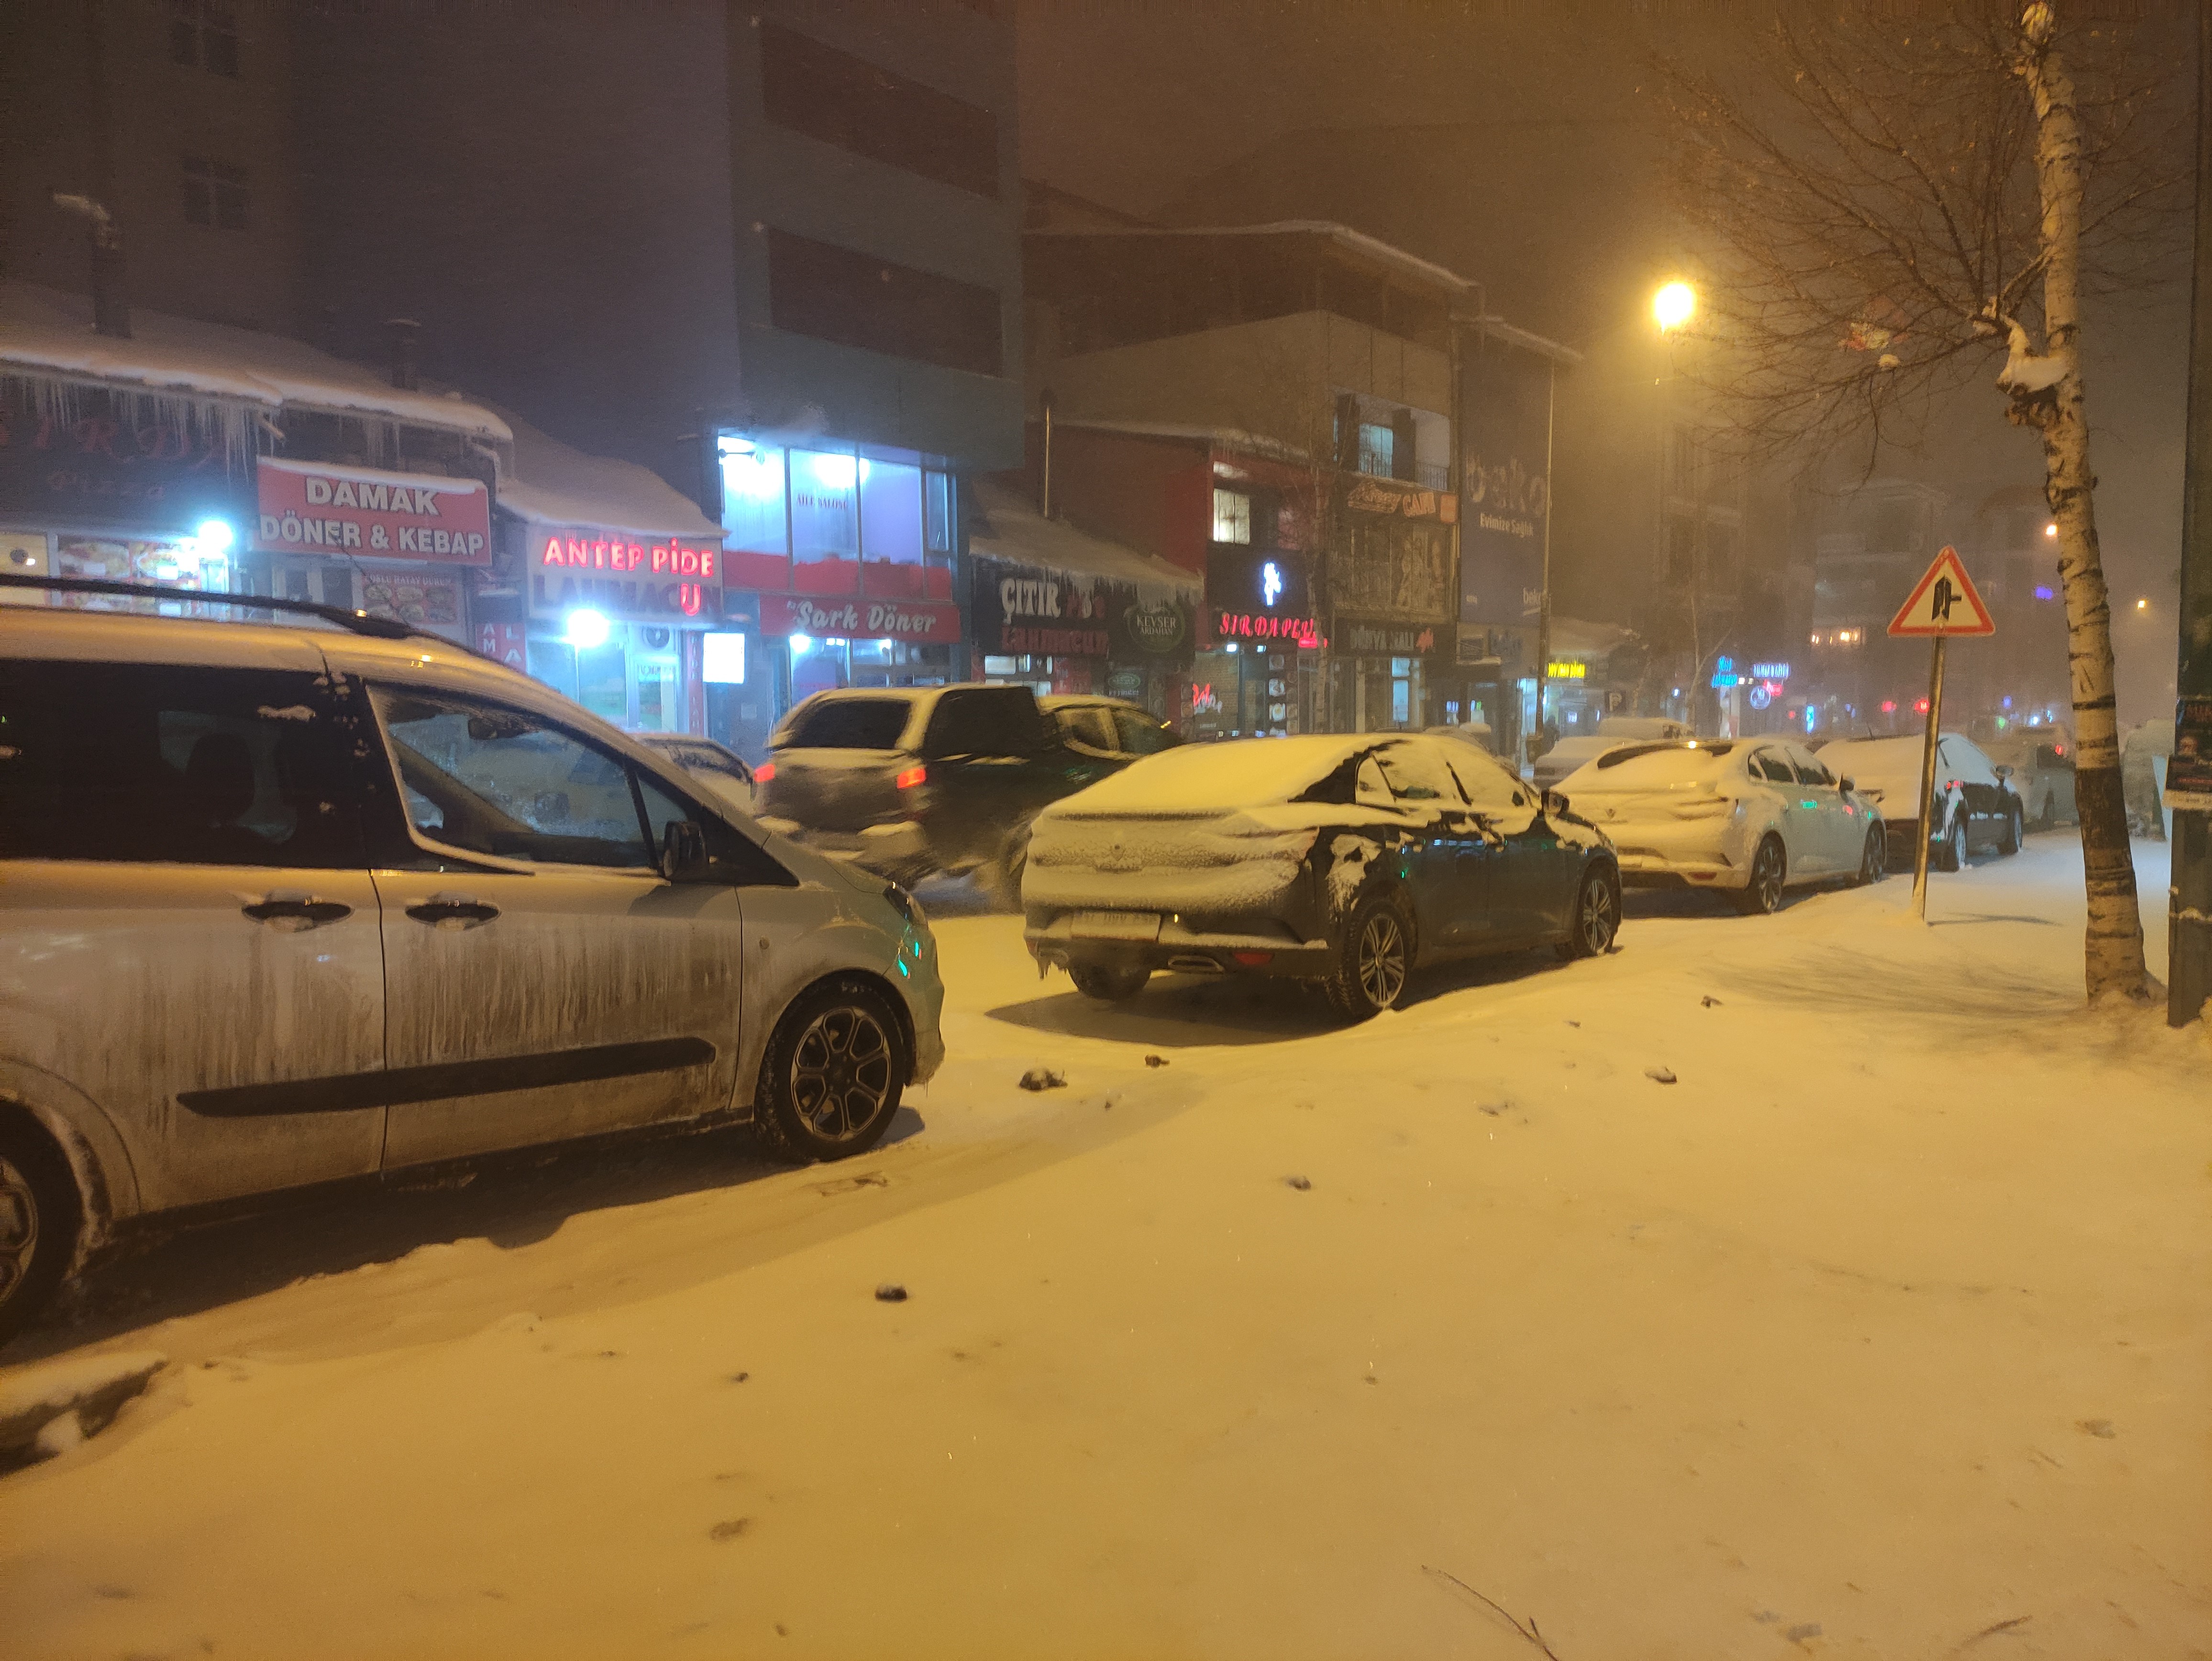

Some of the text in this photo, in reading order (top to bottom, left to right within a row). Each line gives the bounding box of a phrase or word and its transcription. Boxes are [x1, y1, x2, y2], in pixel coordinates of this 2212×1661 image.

[305, 476, 441, 517] DAMAK
[260, 509, 484, 557] DÖNER & KEBAP
[543, 536, 714, 577] ANTEP PİDE
[867, 605, 937, 633] Döner
[1001, 578, 1061, 624] ÇITIR
[1136, 615, 1177, 629] KEVSER
